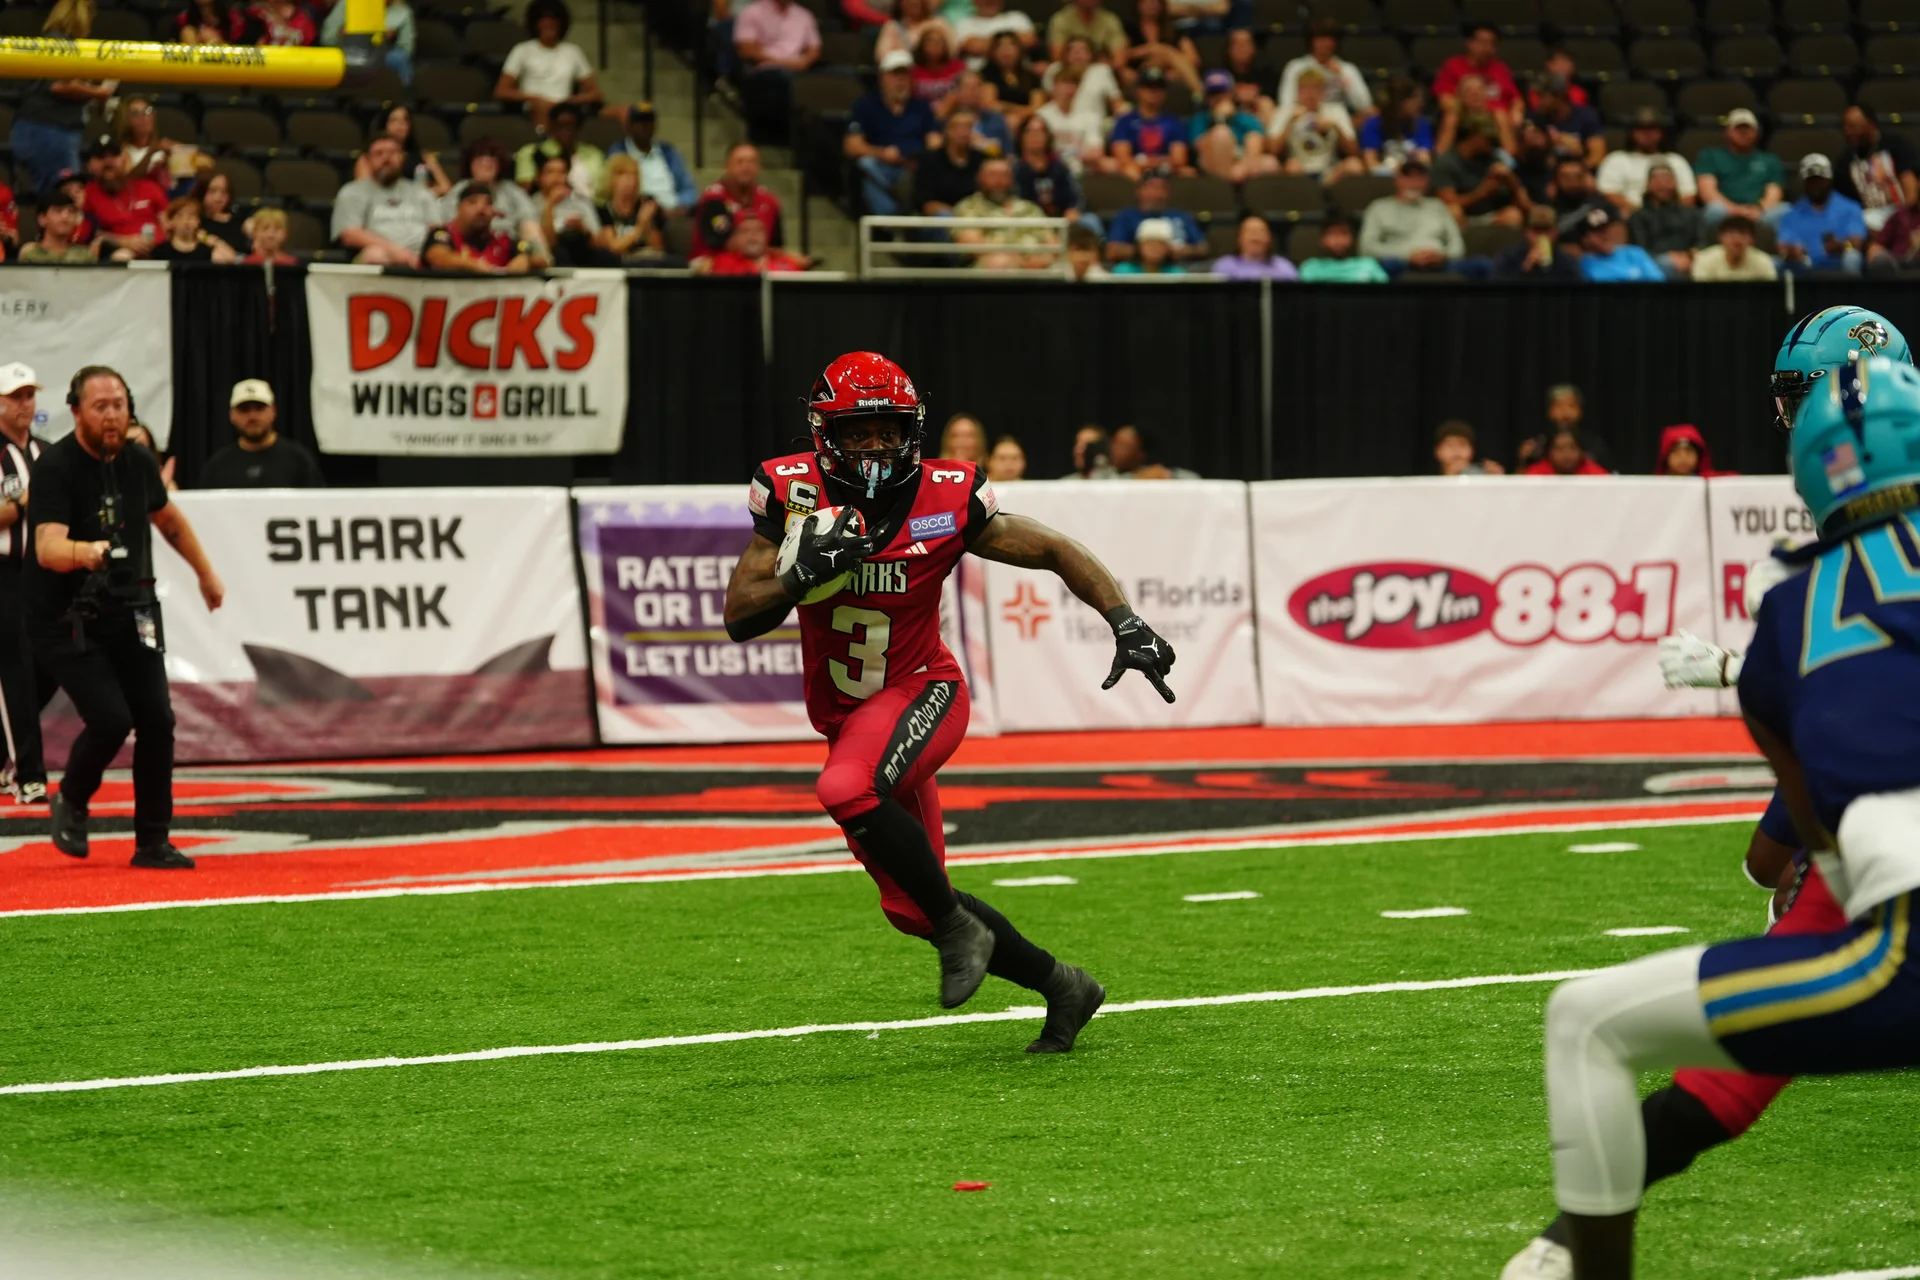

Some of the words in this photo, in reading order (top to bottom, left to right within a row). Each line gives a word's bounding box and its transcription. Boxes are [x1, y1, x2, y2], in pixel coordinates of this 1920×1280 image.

[348, 287, 598, 372] DICK'S
[353, 383, 467, 417] WINGS
[503, 383, 597, 417] GRILL
[858, 398, 890, 407] Riddell
[789, 481, 818, 508] C
[911, 514, 953, 531] oscar
[1731, 507, 1777, 533] YOU
[266, 516, 466, 562] SHARK
[294, 585, 452, 631] TANK
[634, 592, 693, 627] OR
[1492, 563, 1677, 645] 88.1
[624, 645, 691, 677] LET
[693, 644, 745, 677] US
[828, 605, 892, 700] 3
[883, 680, 951, 785] ACKSONVILLE
